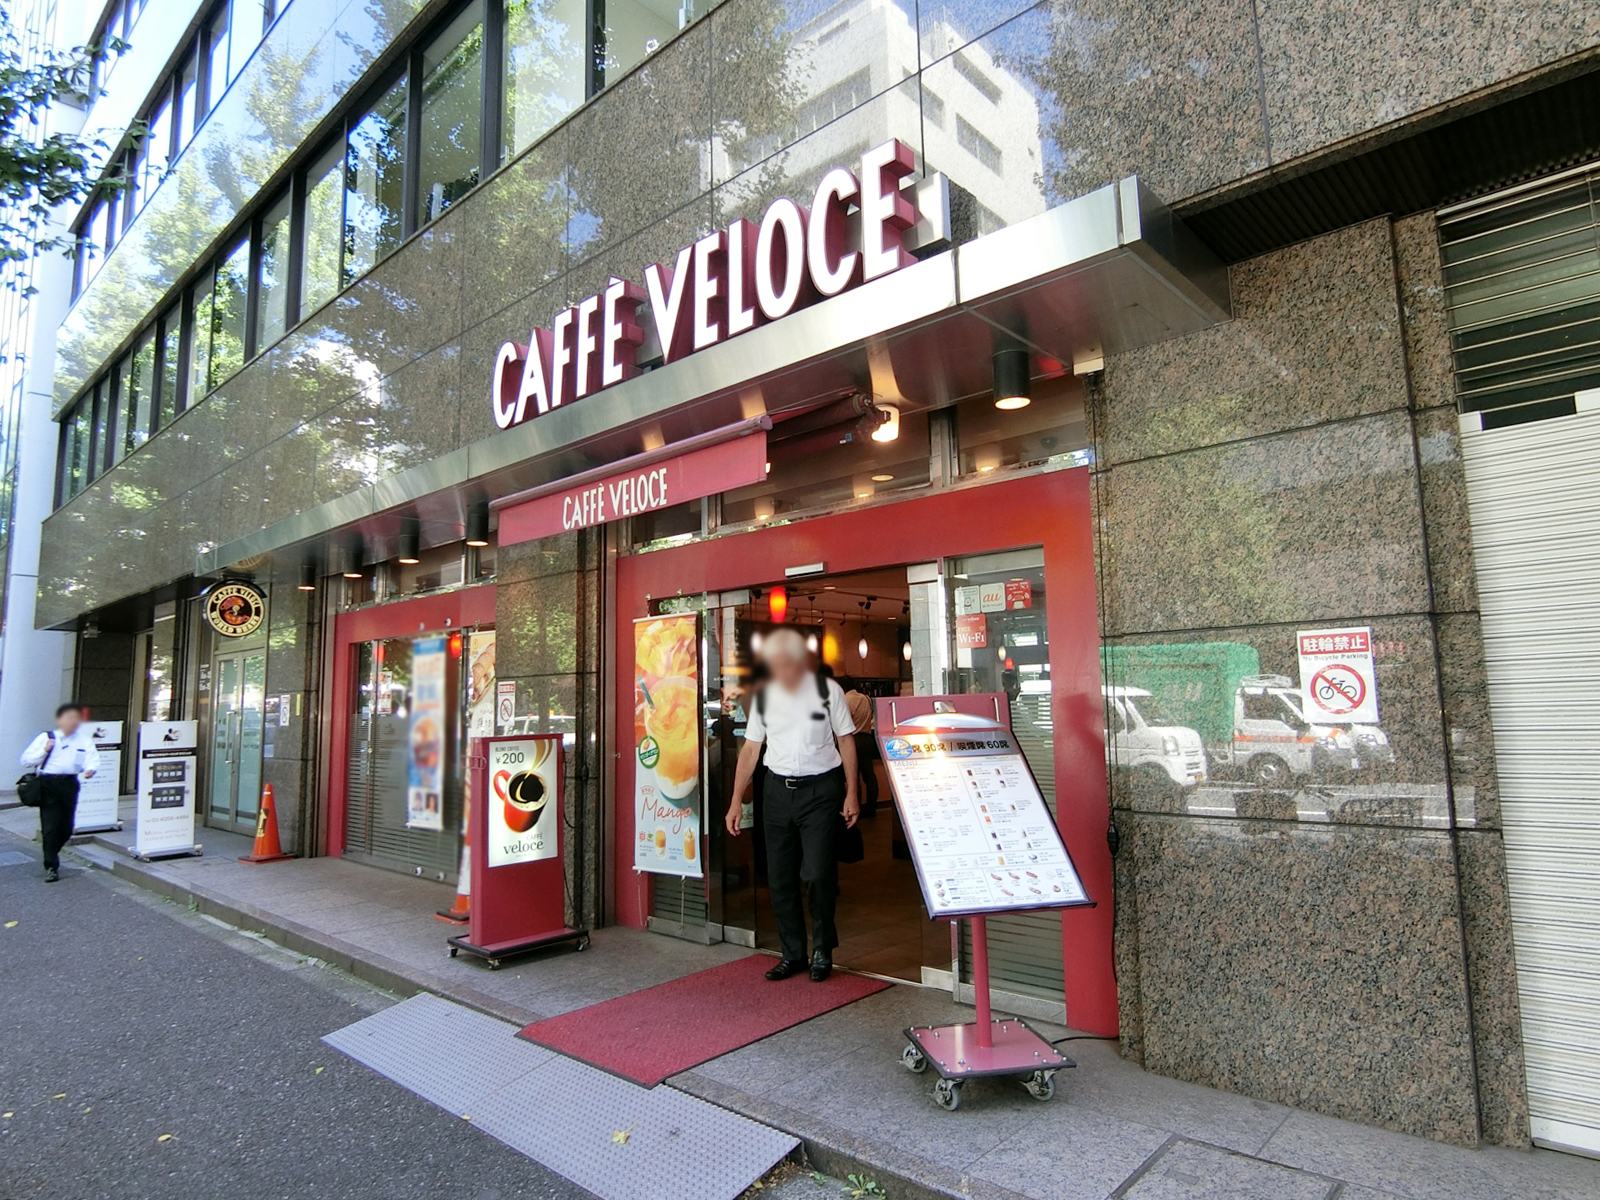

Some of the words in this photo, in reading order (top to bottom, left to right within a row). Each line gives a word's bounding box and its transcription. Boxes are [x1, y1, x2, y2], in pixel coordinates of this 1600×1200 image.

[492, 276, 636, 430] CAFFÈ
[644, 138, 906, 364] VELOCE
[562, 482, 605, 530] CAFFÈ
[609, 468, 668, 516] VELOCE
[983, 593, 1001, 603] au
[211, 611, 235, 634] WORLD
[1302, 635, 1367, 652] 駐輪禁止
[894, 759, 918, 767] MENU
[641, 797, 692, 835] Mango
[503, 840, 545, 855] veloce
